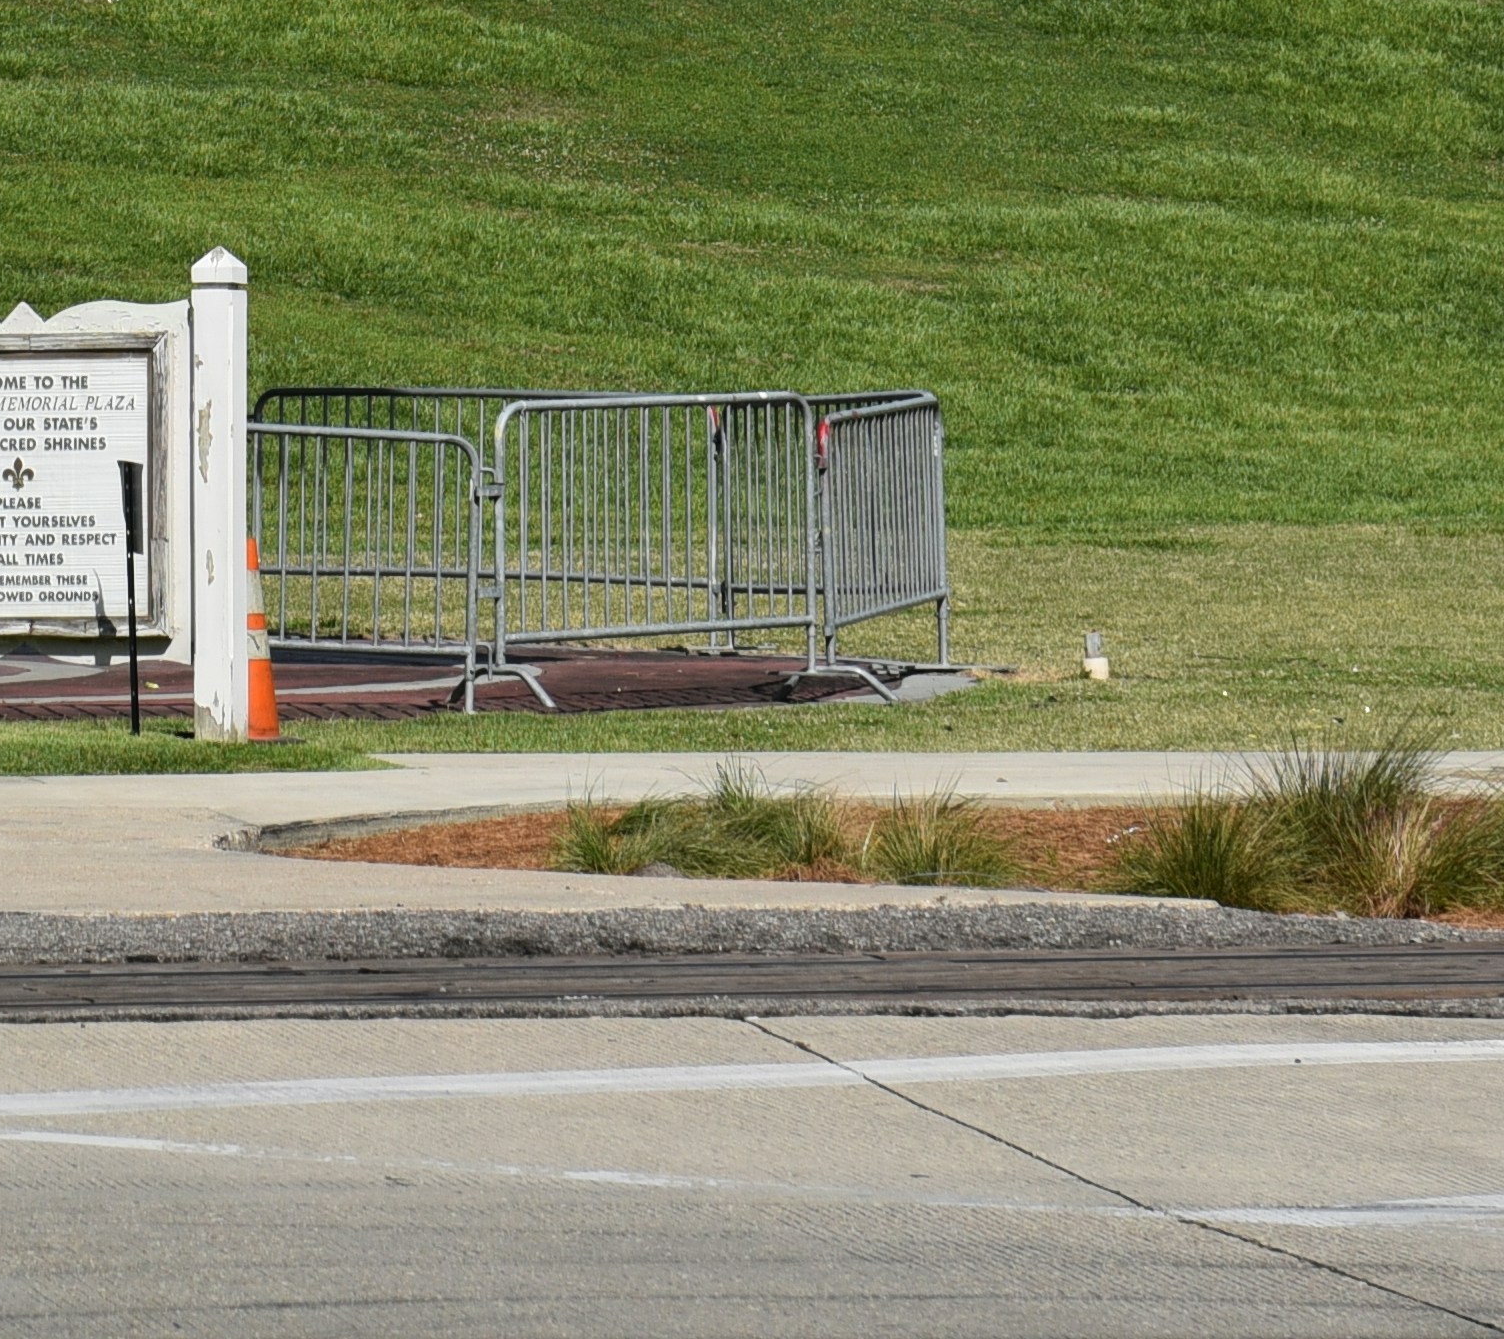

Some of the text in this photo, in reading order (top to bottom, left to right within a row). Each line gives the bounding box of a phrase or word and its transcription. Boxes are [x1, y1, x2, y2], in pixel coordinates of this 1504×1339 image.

[34, 376, 54, 390] TO
[61, 376, 88, 390] THE
[84, 395, 135, 411] PLAZA
[3, 417, 35, 431] OUR
[43, 417, 97, 431] STATE'S
[44, 437, 106, 451] SHRINES
[12, 515, 96, 528] YOURSELVES
[25, 533, 55, 546] AND
[62, 533, 117, 546] RESPECT
[25, 552, 64, 565] TIMES
[56, 574, 88, 586] THESE
[38, 590, 99, 602] GROUNDS
